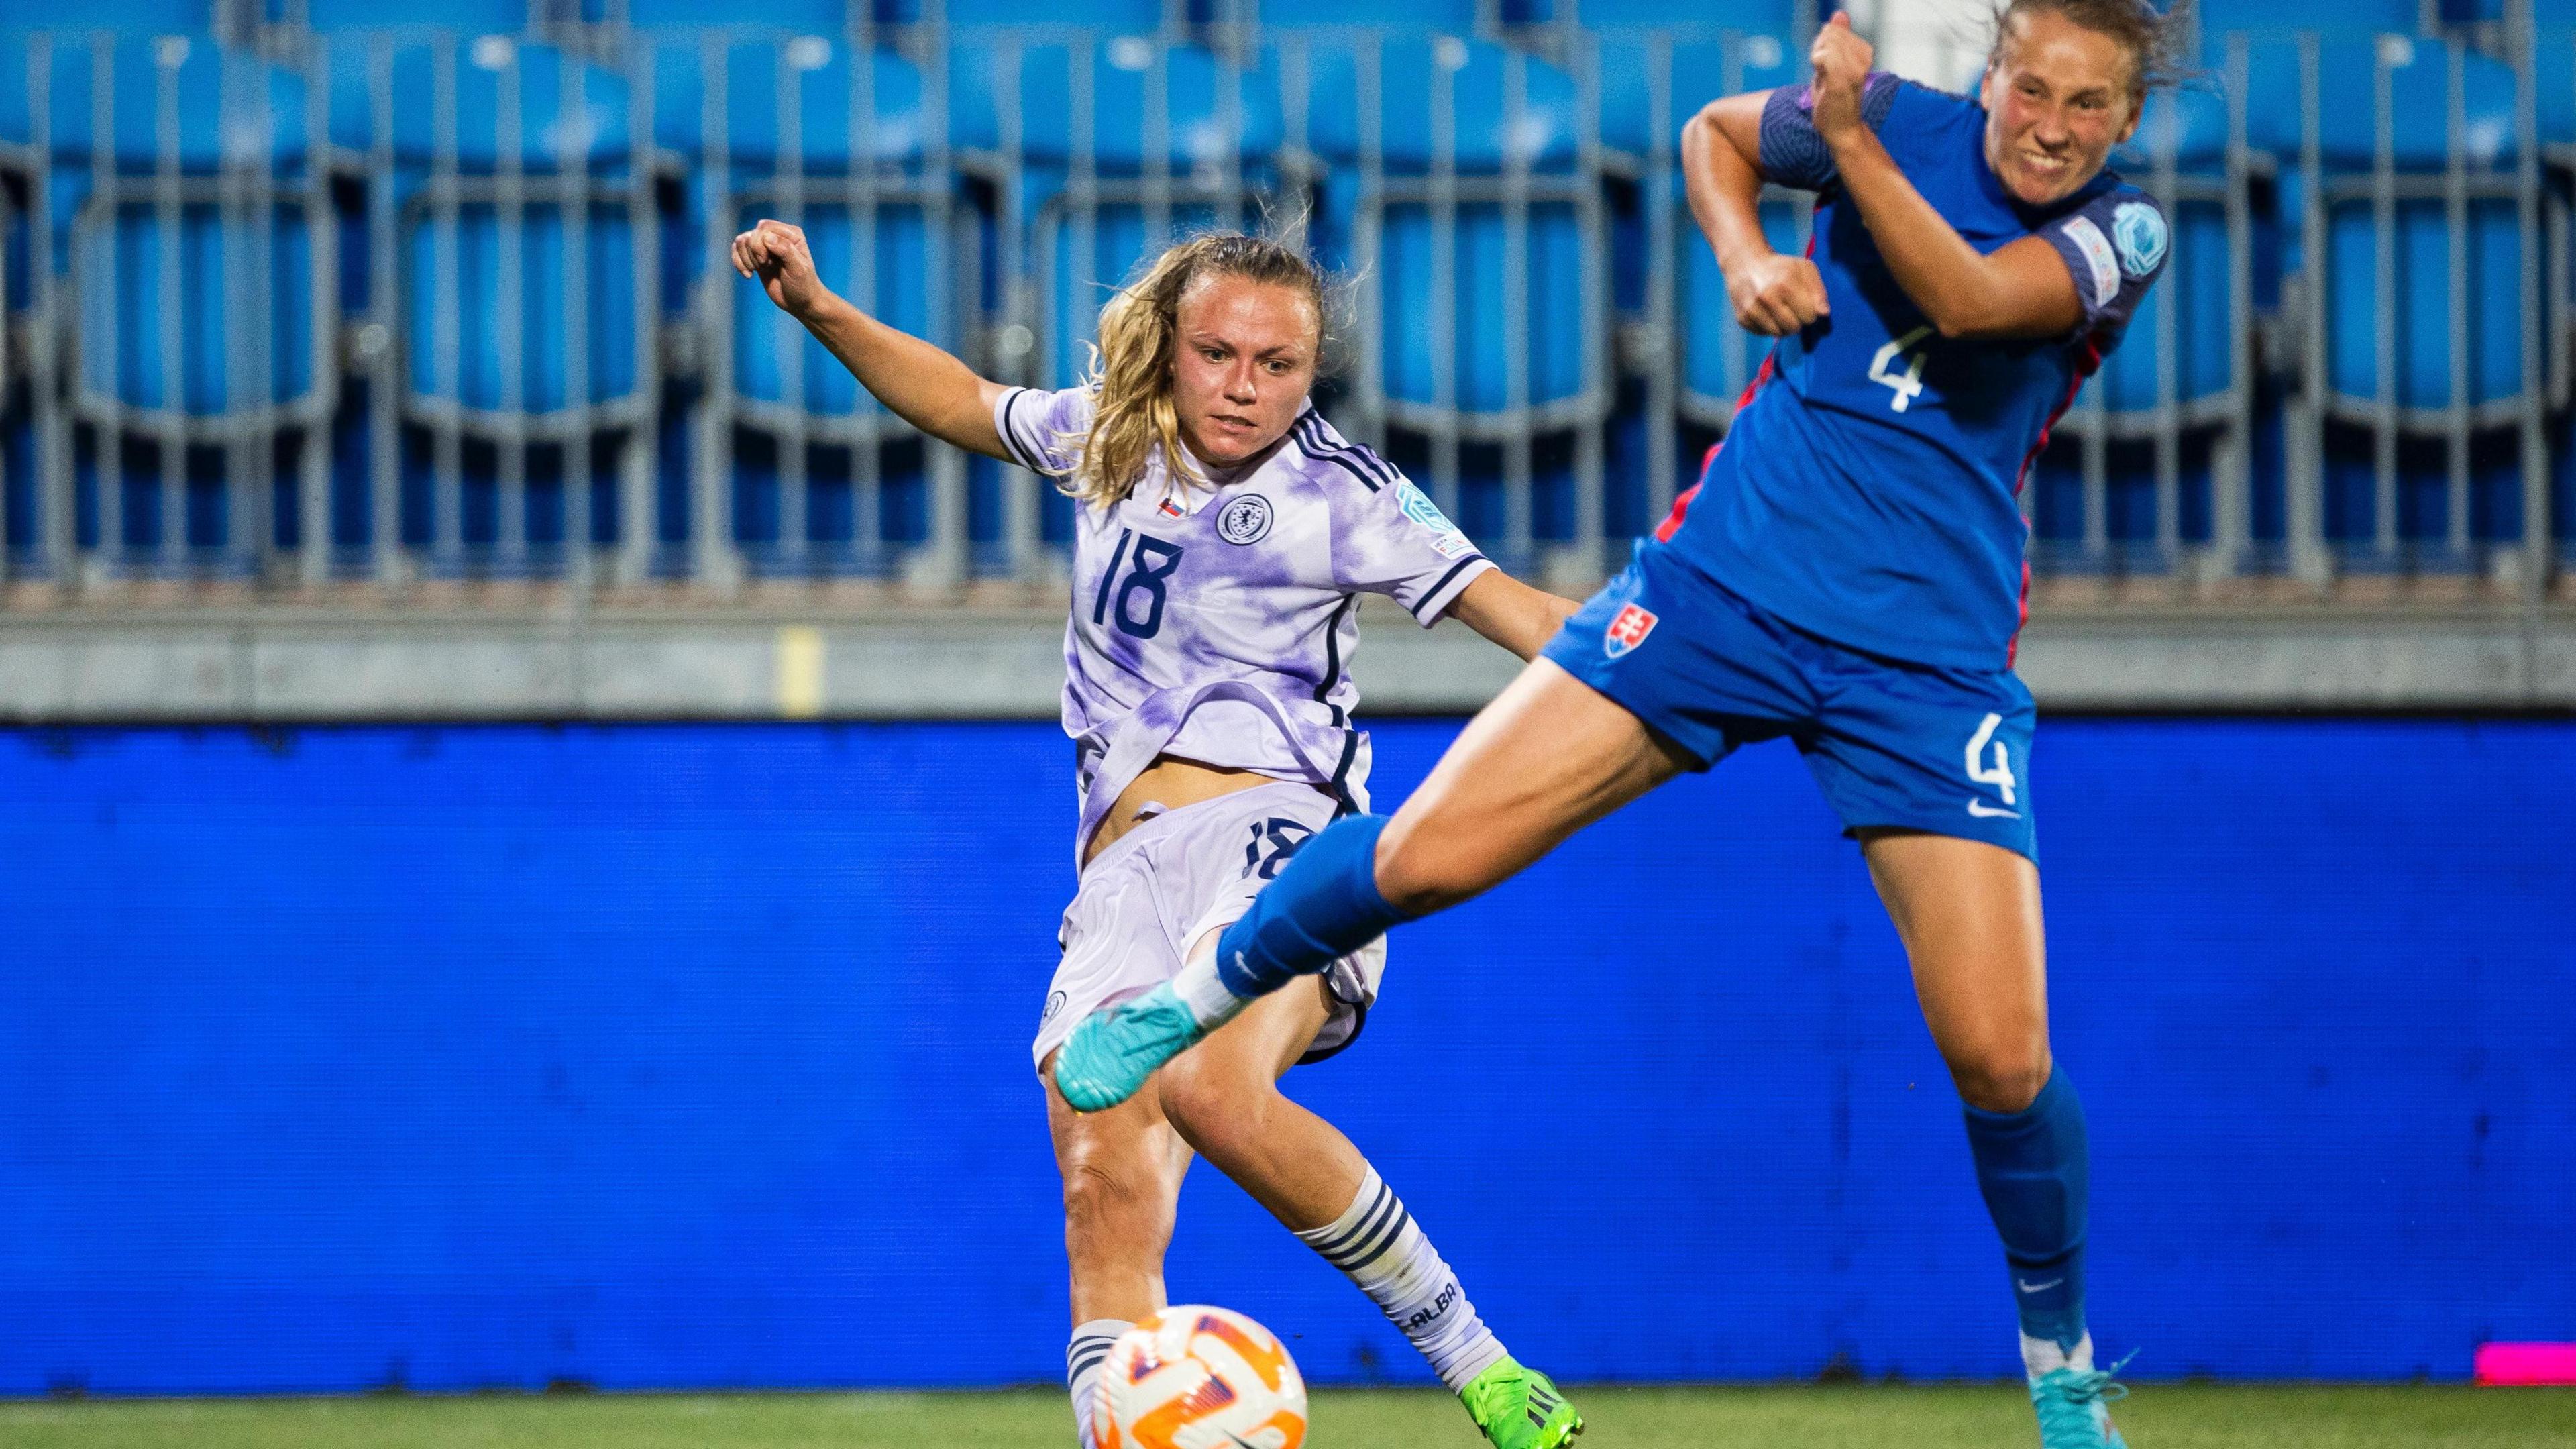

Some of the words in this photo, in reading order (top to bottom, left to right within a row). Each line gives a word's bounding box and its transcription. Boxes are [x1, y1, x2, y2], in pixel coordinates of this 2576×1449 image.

[1868, 325, 1930, 413] 4
[1093, 527, 1185, 639] 18
[1965, 712, 2016, 805] 4
[1241, 817, 1320, 881] 18
[1409, 1282, 1456, 1328] ALBA
